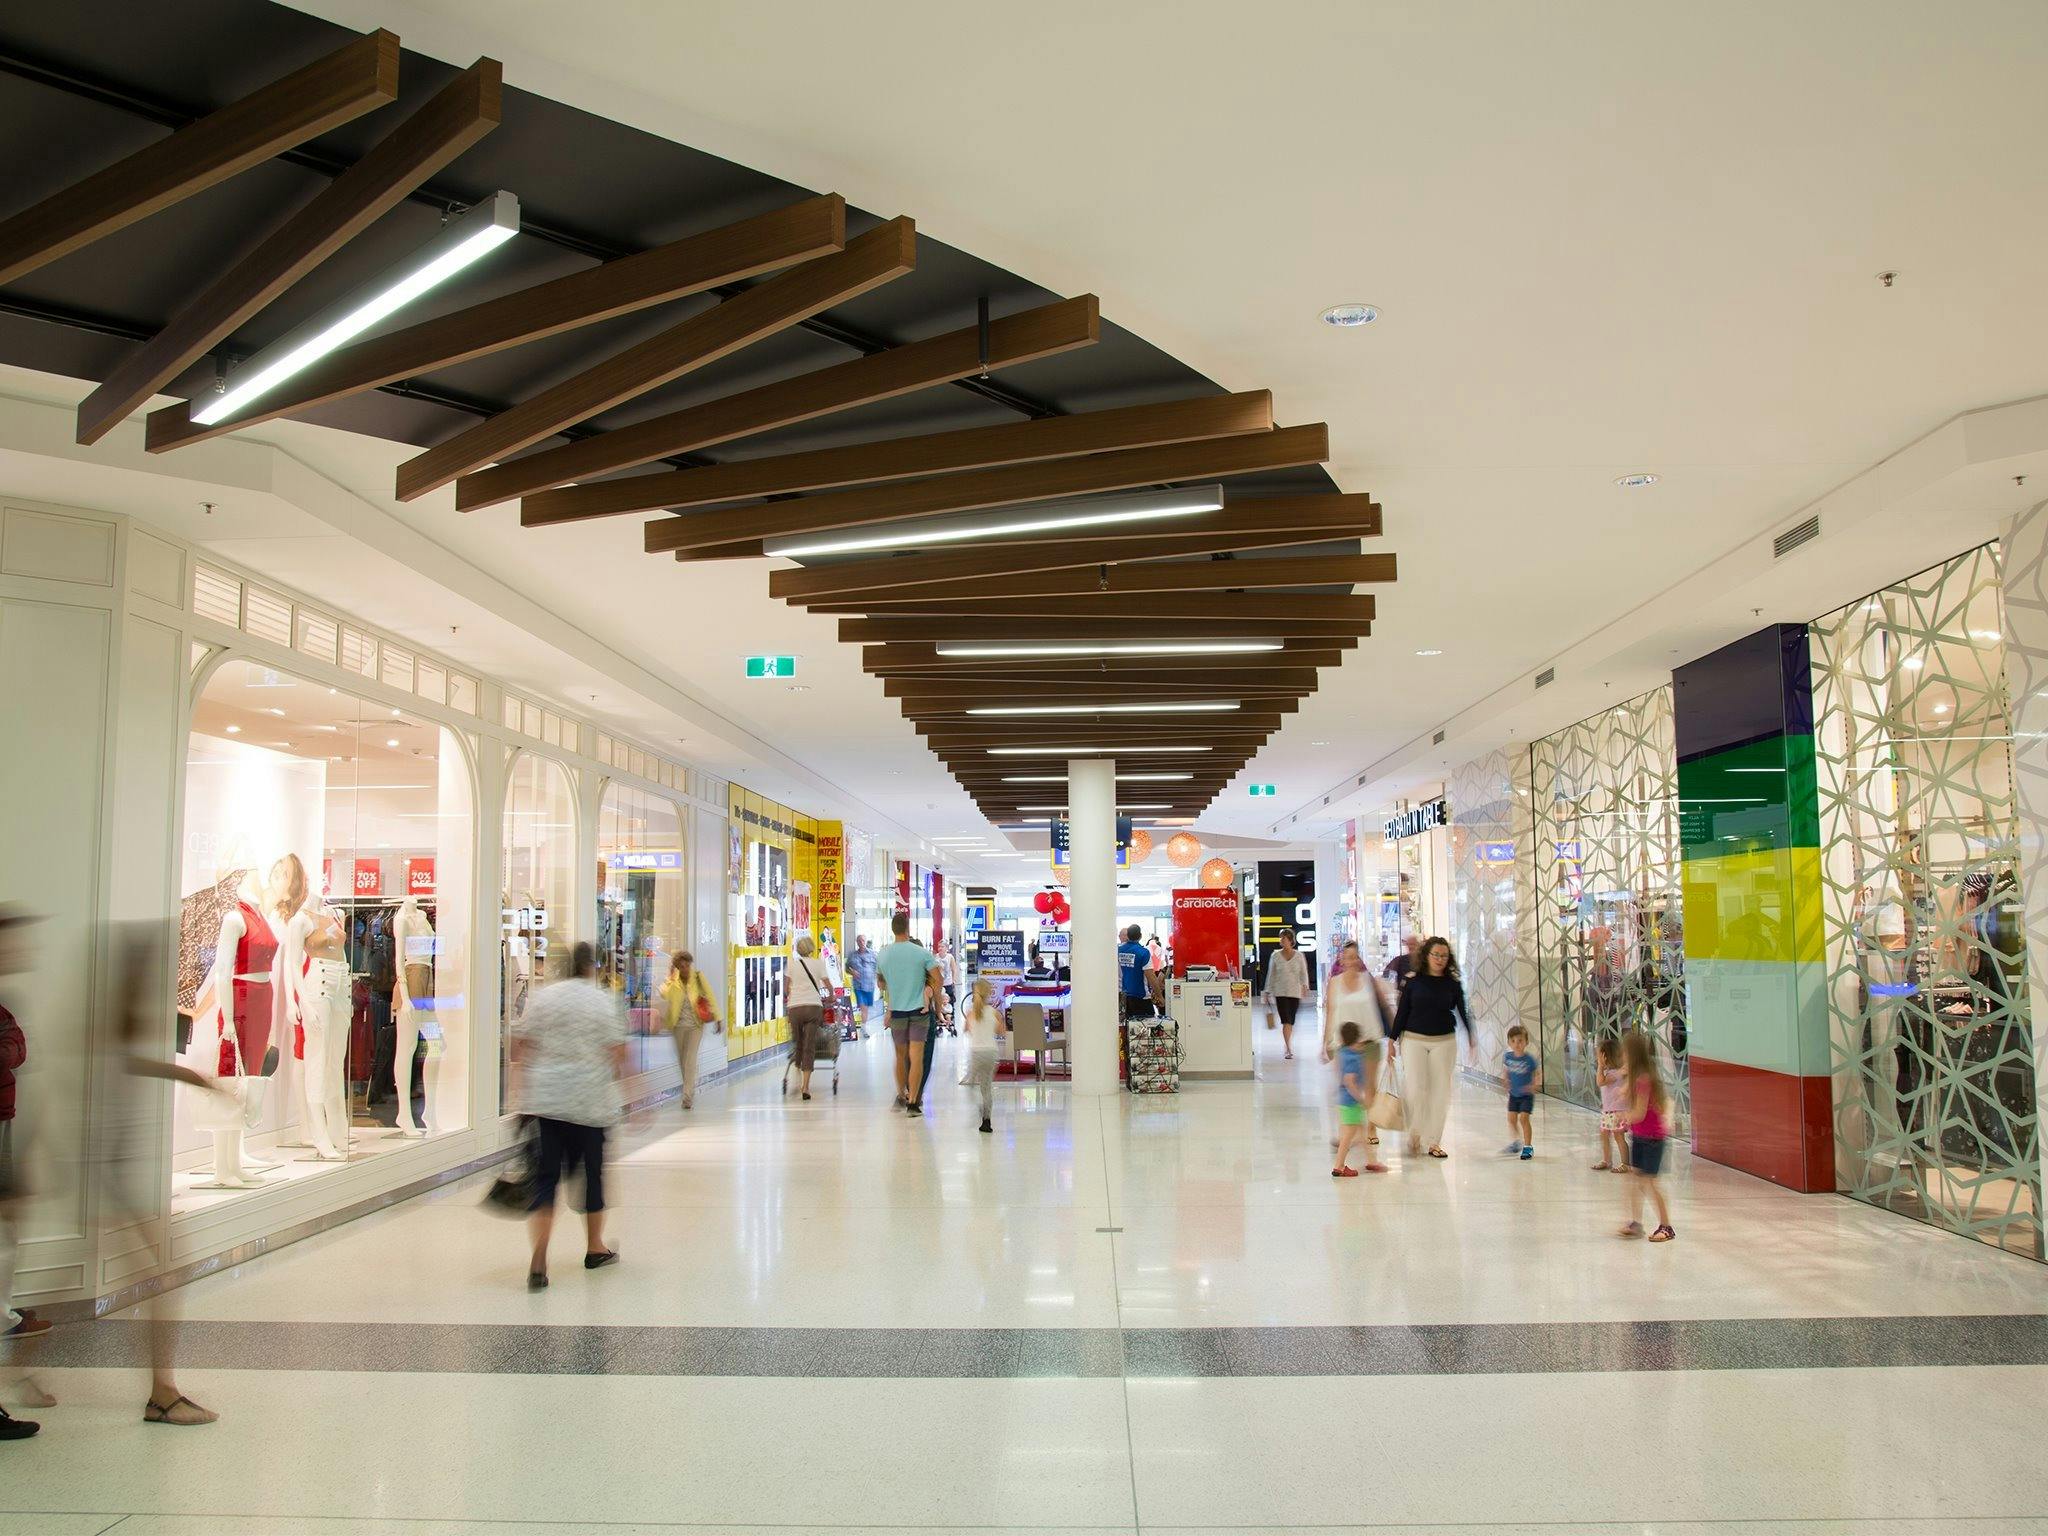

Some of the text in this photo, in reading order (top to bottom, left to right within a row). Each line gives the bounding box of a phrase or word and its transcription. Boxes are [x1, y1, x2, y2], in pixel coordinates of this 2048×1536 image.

[1384, 819, 1396, 842] BED
[1396, 811, 1412, 839] BATH
[1419, 801, 1445, 832] TABLE
[818, 836, 841, 847] MOBILE
[357, 872, 377, 880] 70%
[411, 872, 431, 880] 70%
[819, 891, 840, 900] STORE
[1175, 897, 1237, 909] CardioTech
